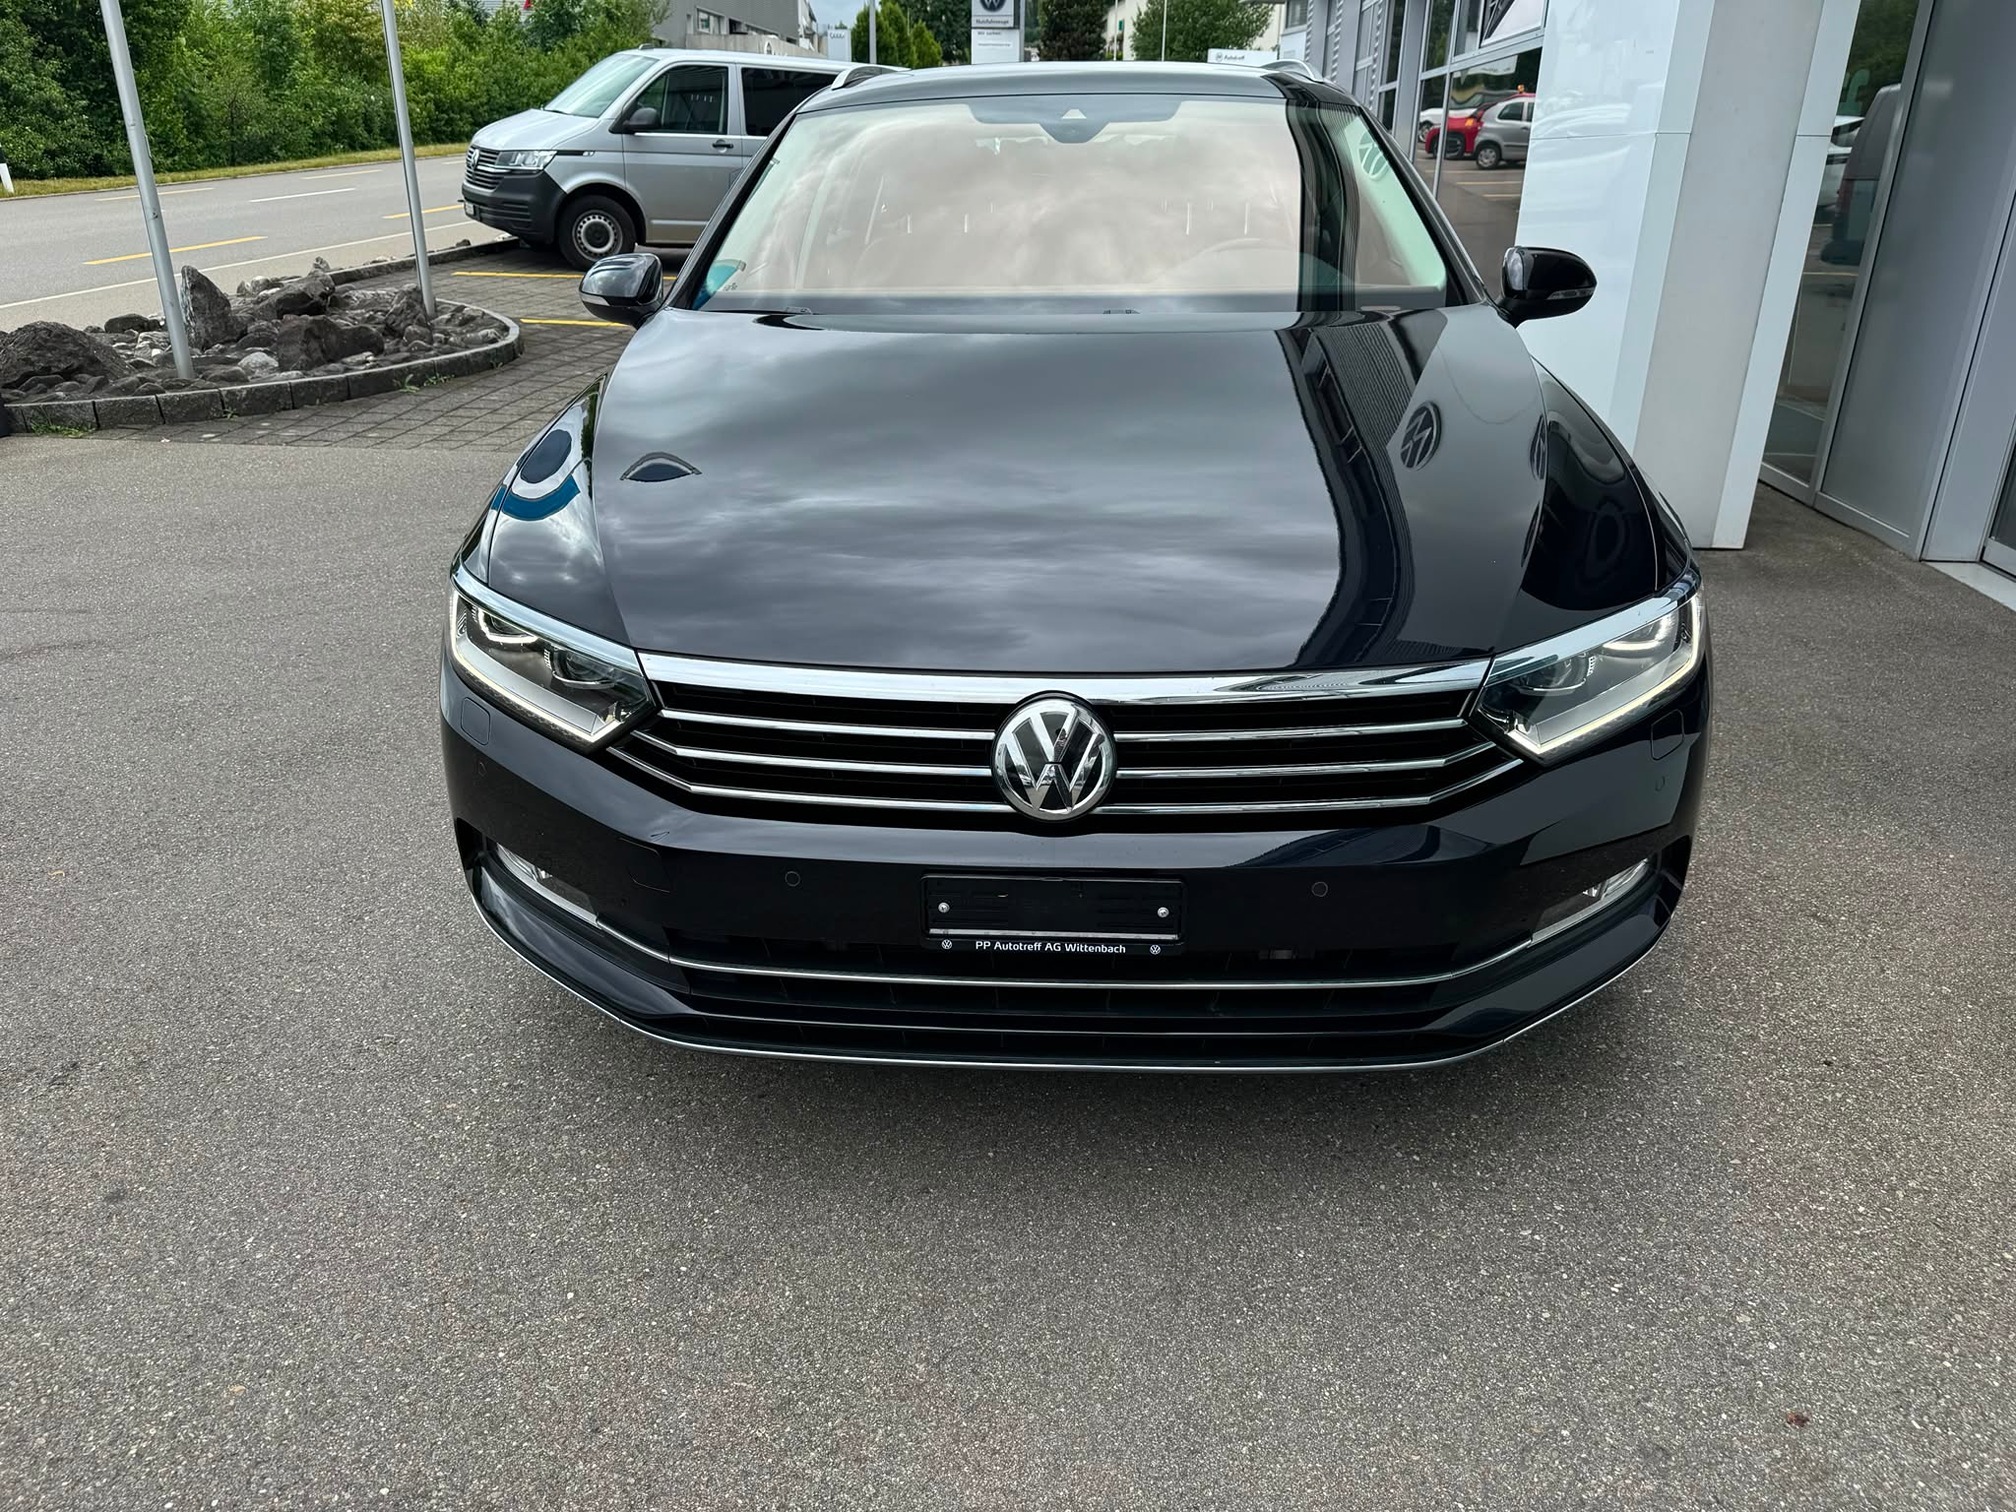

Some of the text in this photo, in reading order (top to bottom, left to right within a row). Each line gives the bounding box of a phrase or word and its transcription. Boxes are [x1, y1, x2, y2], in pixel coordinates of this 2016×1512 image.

[975, 940, 991, 950] PP
[994, 941, 1043, 951] Autotreff
[1045, 942, 1062, 952] AG
[1065, 943, 1126, 954] Wittenbach
